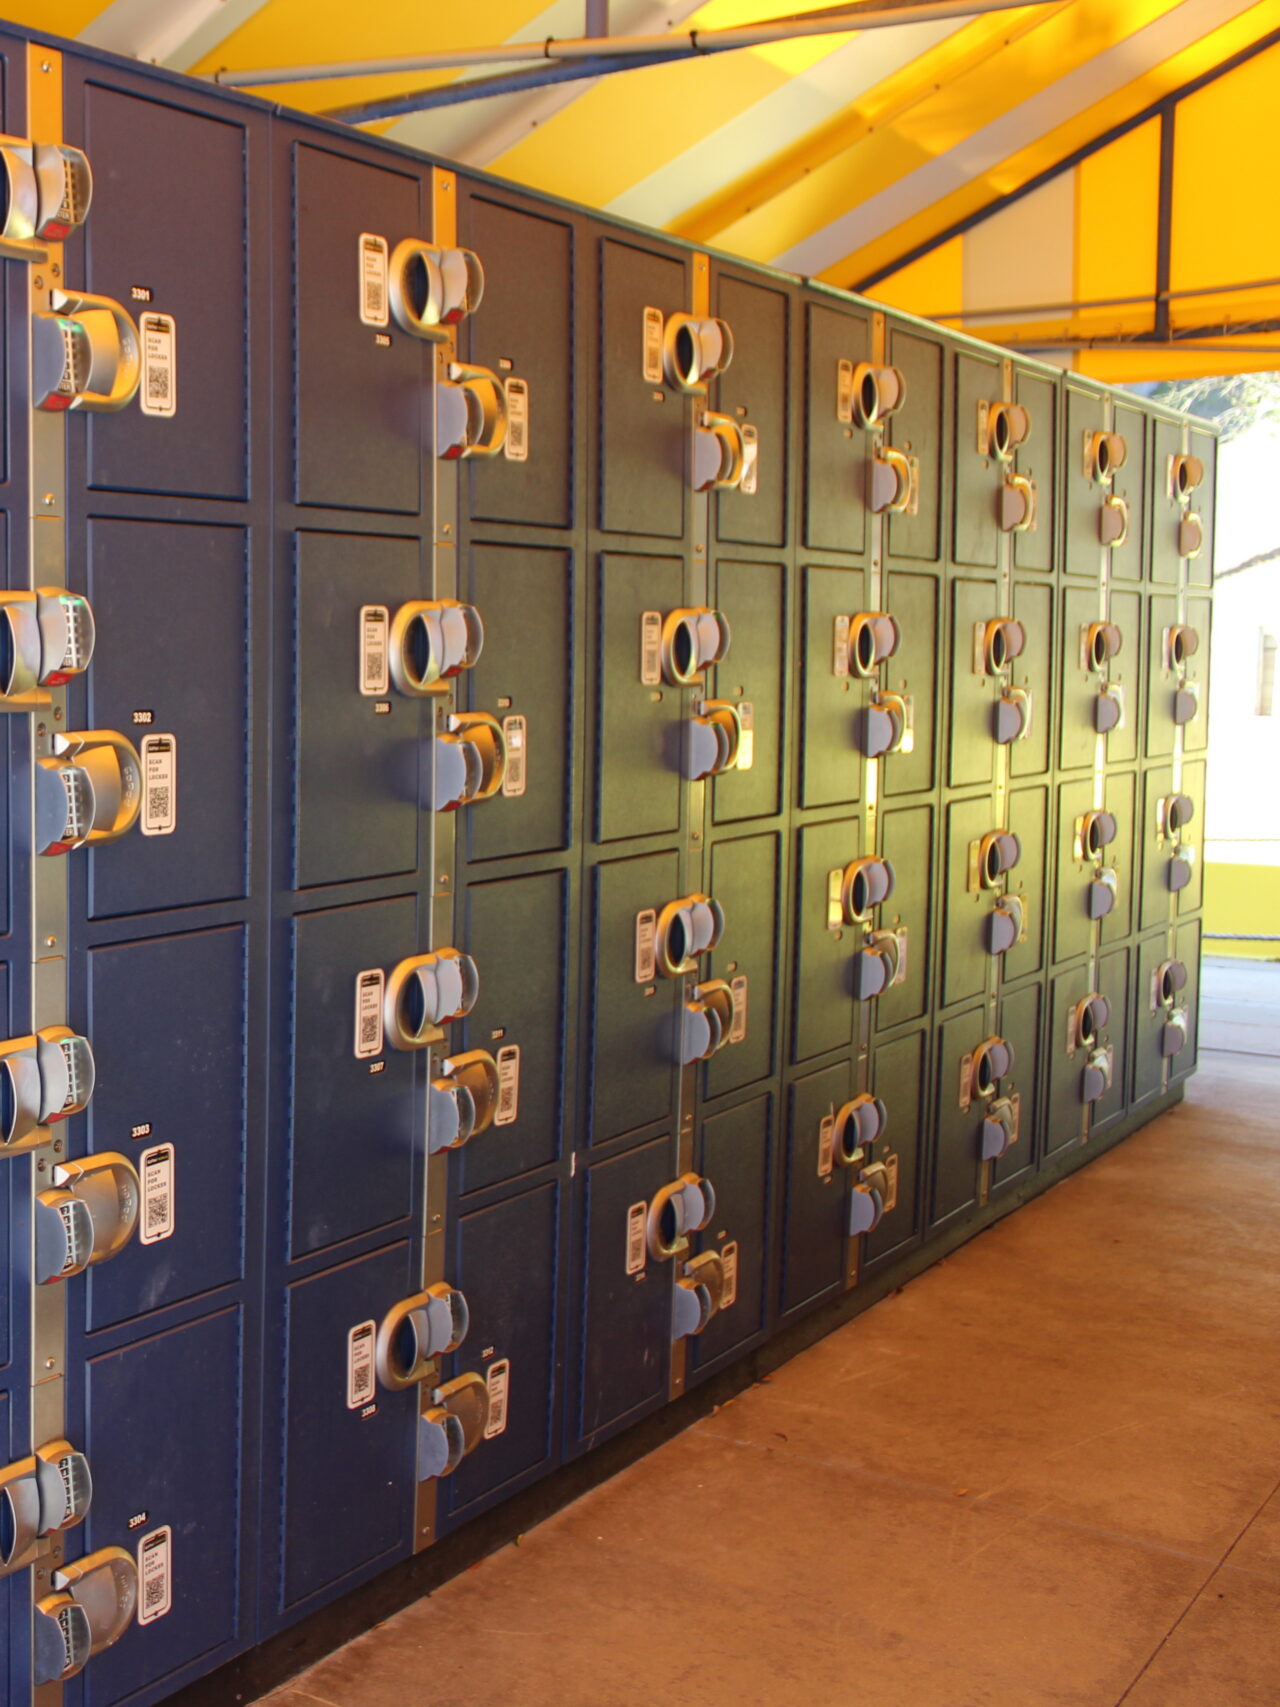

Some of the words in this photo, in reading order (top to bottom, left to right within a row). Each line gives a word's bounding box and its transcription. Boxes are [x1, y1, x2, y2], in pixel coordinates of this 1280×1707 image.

[131, 287, 150, 302] 3301
[133, 711, 152, 723] 3302
[132, 1123, 150, 1138] 3303
[128, 1511, 146, 1528] 3304
